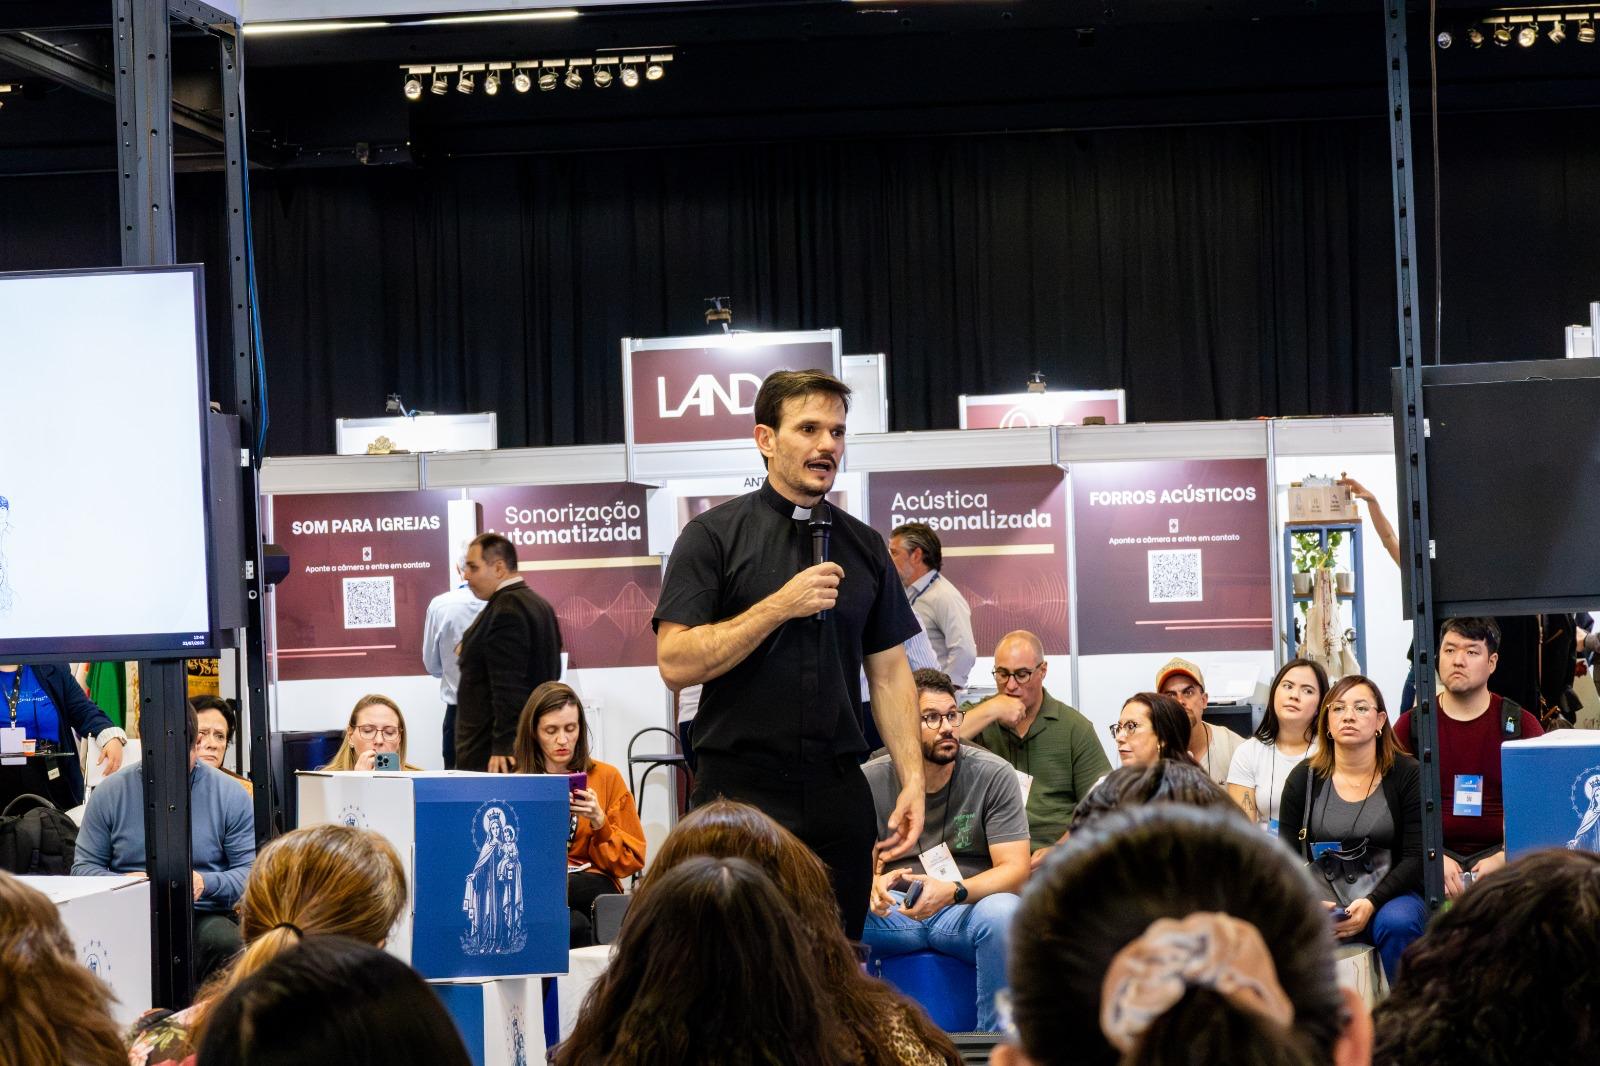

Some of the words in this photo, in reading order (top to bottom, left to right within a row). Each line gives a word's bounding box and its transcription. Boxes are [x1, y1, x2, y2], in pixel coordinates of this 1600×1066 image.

[657, 372, 764, 418] LAND
[744, 477, 766, 487] ANT
[891, 490, 988, 511] Acústica
[1089, 490, 1156, 506] FORROS
[1160, 484, 1257, 504] ACÚSTICOS
[505, 501, 640, 525] Sonorização
[292, 520, 328, 535] SOM
[332, 519, 373, 533] PARA
[377, 515, 441, 531] IGREJAS
[488, 522, 641, 545] utomatizada
[1109, 536, 1135, 545] Aponte
[1143, 535, 1171, 543] câmera
[305, 566, 330, 574] Aponte
[338, 563, 364, 571] câmera
[403, 561, 431, 569] contato
